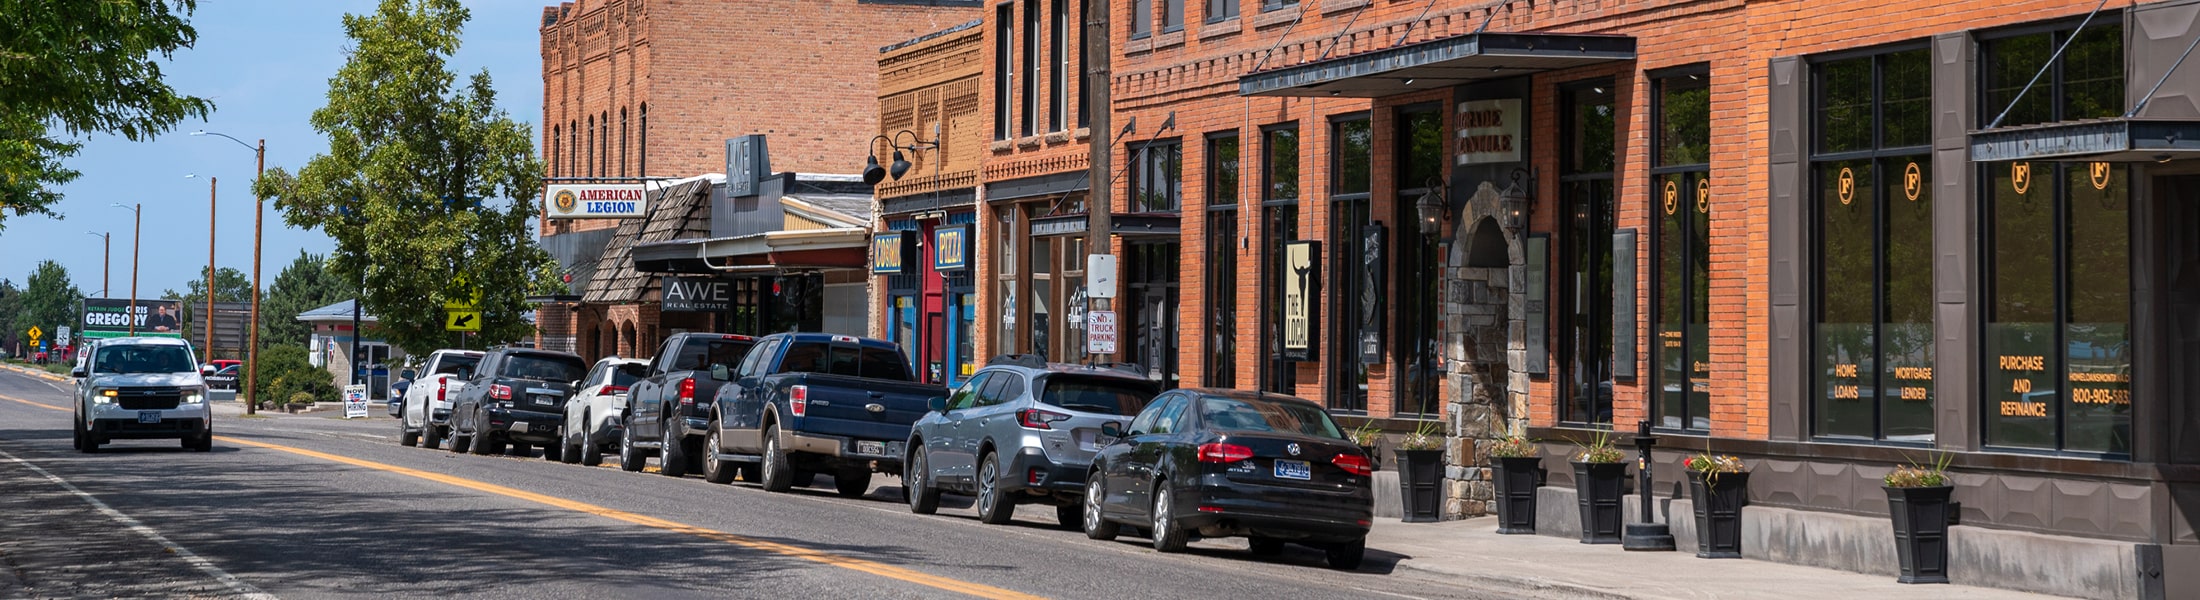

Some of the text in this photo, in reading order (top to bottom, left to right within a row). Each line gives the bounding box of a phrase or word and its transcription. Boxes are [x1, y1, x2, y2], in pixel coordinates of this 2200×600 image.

[580, 189, 643, 201] AMERICAN
[587, 201, 635, 213] LEGION
[939, 231, 962, 264] PIZZA
[666, 281, 730, 301] AWE
[125, 305, 148, 314] CRIS
[1288, 294, 1299, 316] THE
[86, 312, 148, 327] GREGORY
[1096, 315, 1108, 323] NO
[1091, 324, 1114, 332] TRUCK
[1287, 318, 1307, 346] LOCAL
[1090, 333, 1115, 342] PARKING
[1835, 363, 1858, 378] HOME
[2000, 355, 2045, 371] PURCHASE
[1895, 366, 1933, 380] MORTGAGE
[1834, 384, 1859, 400] LOANS
[1901, 386, 1927, 400] LENDER
[2012, 378, 2032, 394] AND
[347, 402, 366, 412] HIRING
[2001, 400, 2047, 417] REFINANCE
